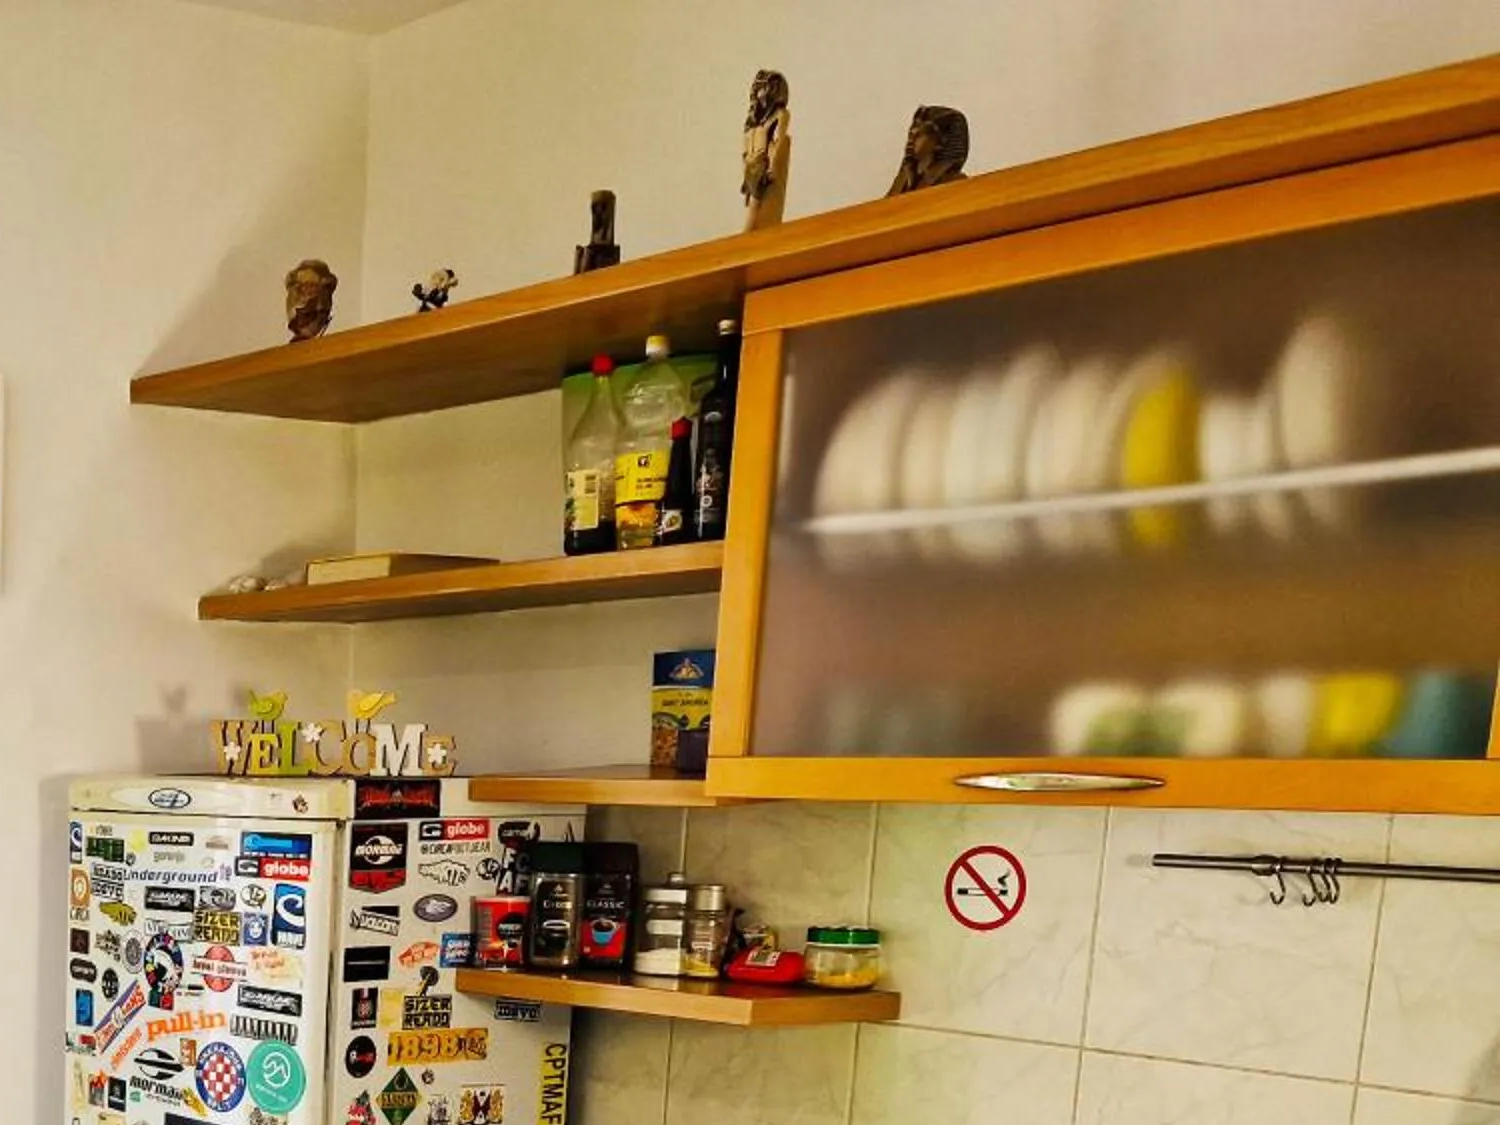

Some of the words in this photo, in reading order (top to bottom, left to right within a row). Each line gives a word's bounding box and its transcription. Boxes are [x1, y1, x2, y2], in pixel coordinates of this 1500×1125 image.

[447, 821, 485, 836] globe
[263, 861, 309, 876] globe
[147, 1011, 228, 1042] pull-in
